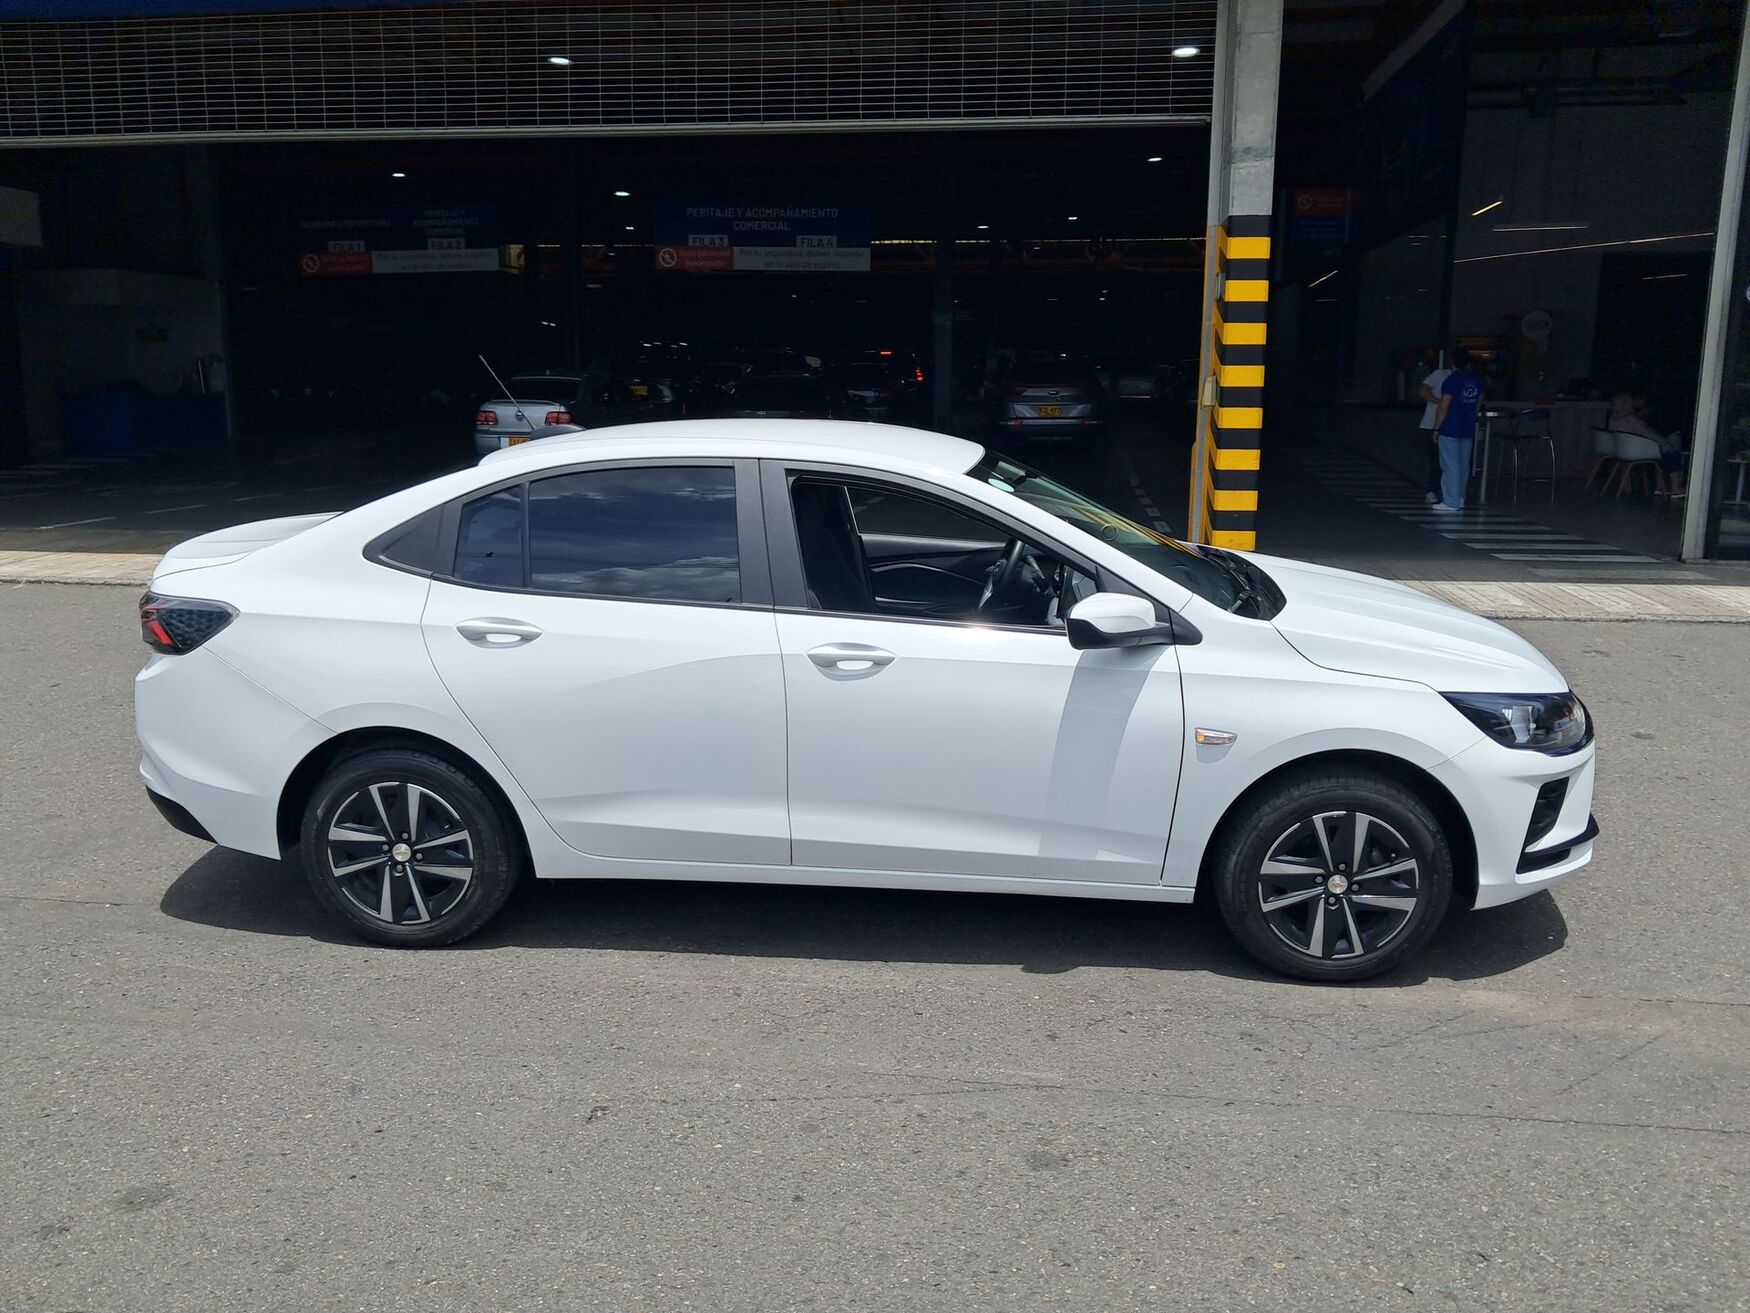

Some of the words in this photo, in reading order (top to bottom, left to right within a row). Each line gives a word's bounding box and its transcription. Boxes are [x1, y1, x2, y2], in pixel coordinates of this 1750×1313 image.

[687, 208, 734, 217] PERITAJE
[736, 208, 744, 217] Y
[746, 206, 838, 218] ACOMPAÑAMIENTO
[733, 221, 790, 231] COMERCIAL
[432, 240, 454, 249] FILA
[693, 237, 716, 246] FILA
[801, 237, 824, 248] FILA
